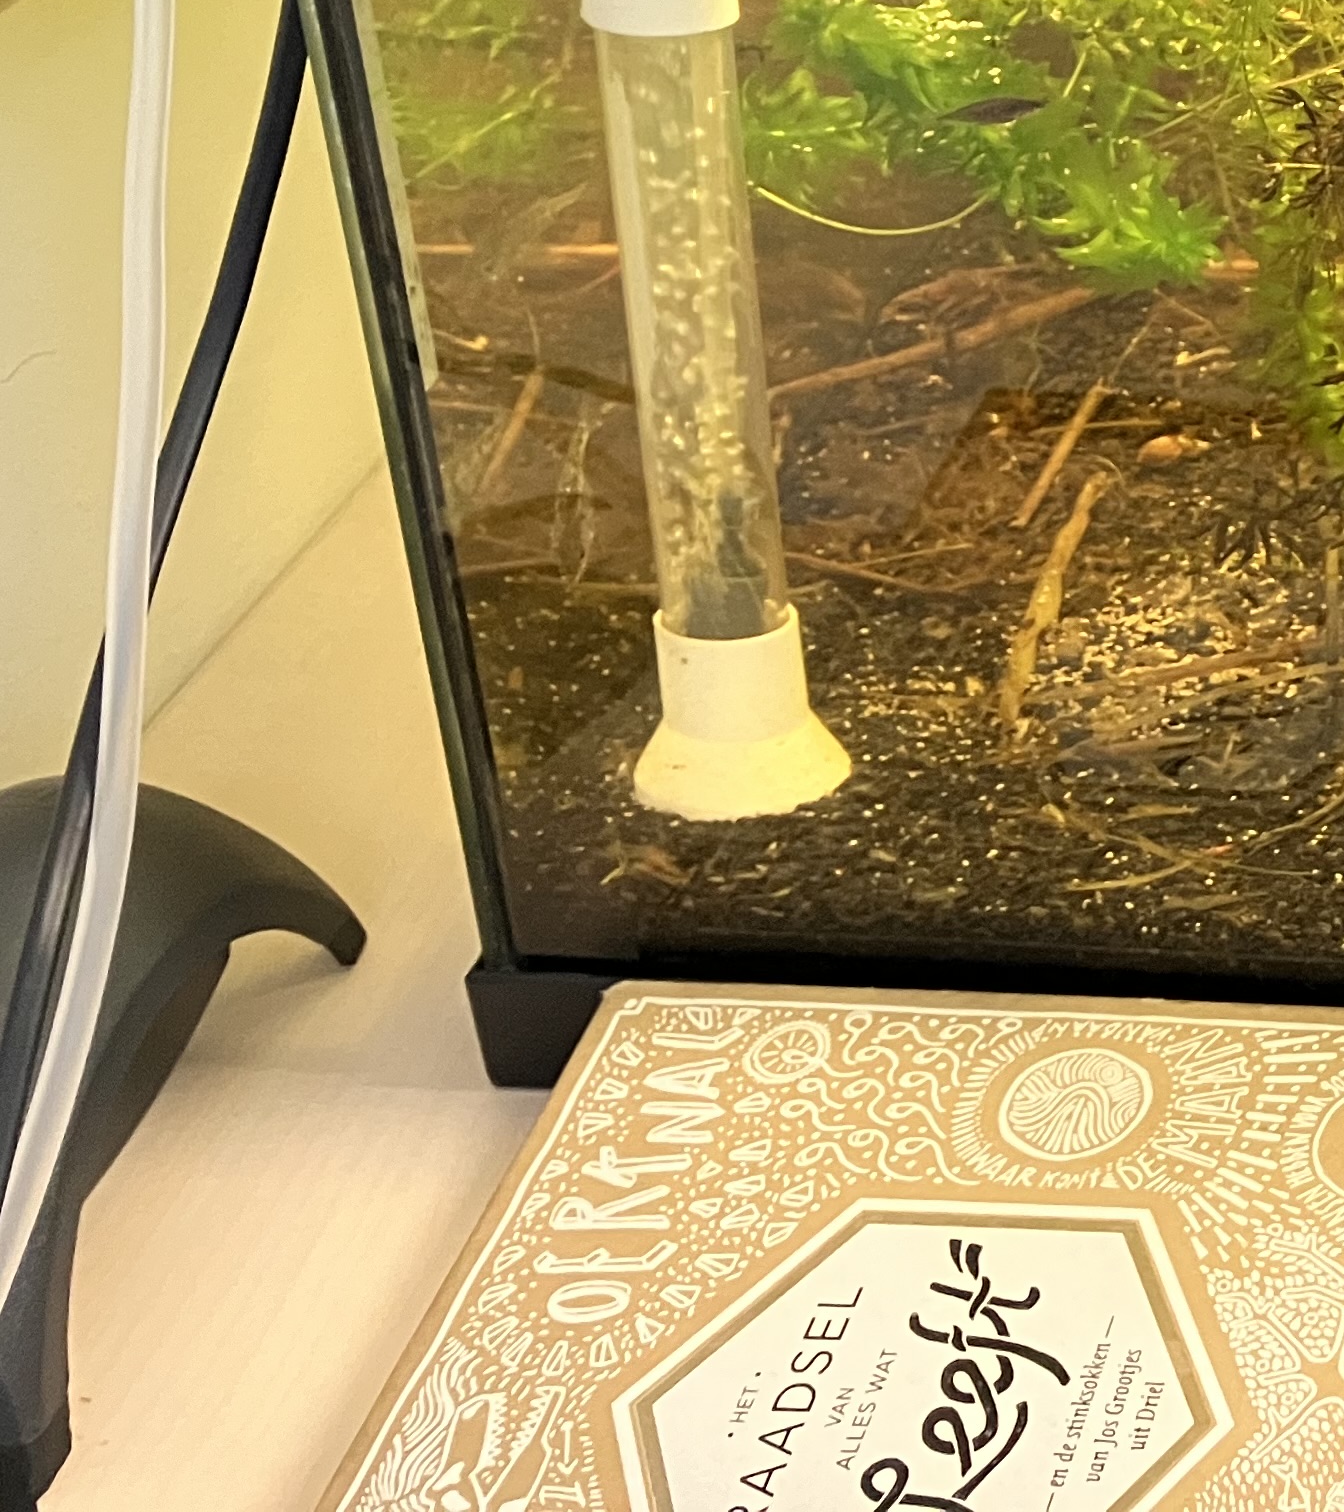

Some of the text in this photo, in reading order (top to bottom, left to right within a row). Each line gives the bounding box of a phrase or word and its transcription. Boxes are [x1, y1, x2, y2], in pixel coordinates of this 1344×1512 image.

[966, 1143, 1037, 1187] WAAR
[1116, 1152, 1168, 1191] DE
[1151, 1028, 1252, 1169] MAAN
[727, 1286, 863, 1512] AADSEL
[729, 1386, 760, 1423] HET
[824, 1387, 855, 1428] VAN
[836, 1348, 898, 1471] ALLES WAT
[1050, 1343, 1111, 1487] en de stinksokken
[1086, 1349, 1142, 1482] van Jos Grootjes
[1128, 1382, 1165, 1450] uit Driel
